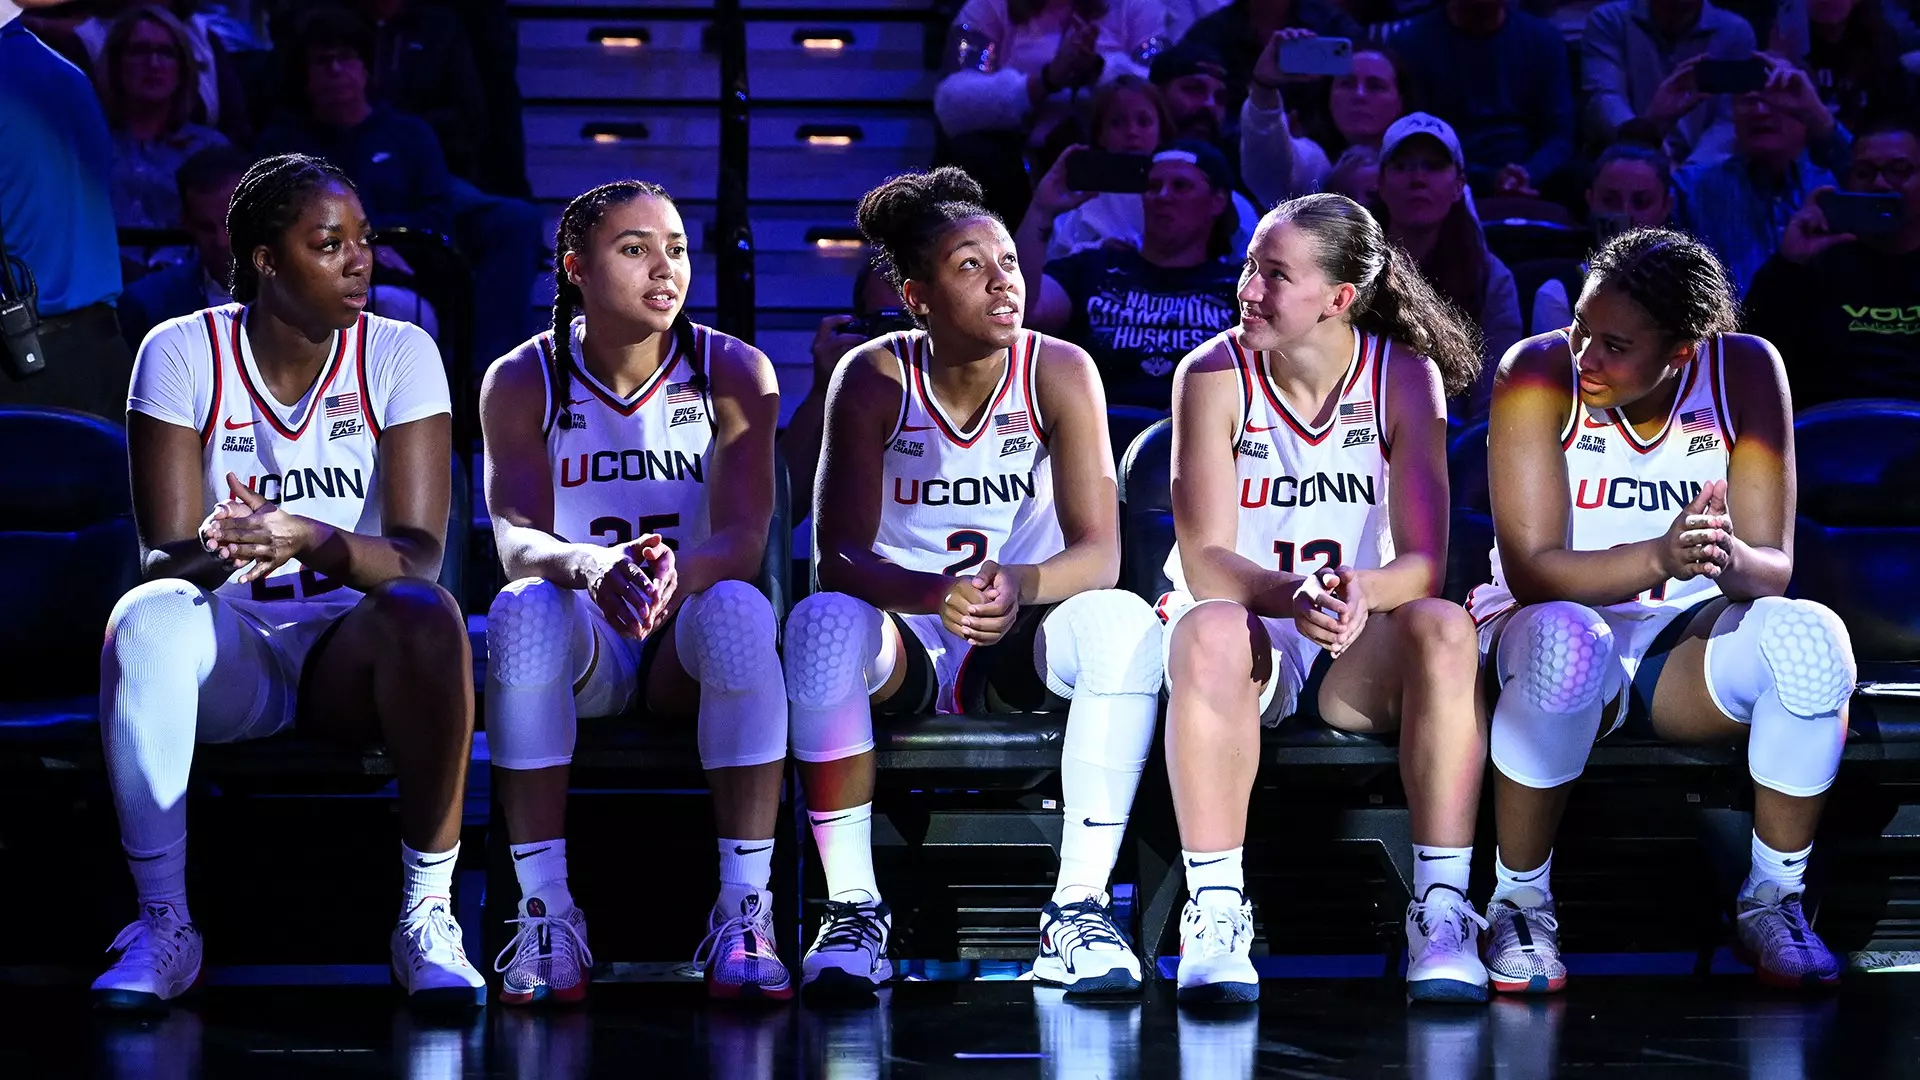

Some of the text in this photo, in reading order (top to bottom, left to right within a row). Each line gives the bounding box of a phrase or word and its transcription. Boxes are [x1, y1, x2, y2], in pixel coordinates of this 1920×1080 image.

[1126, 289, 1204, 312] NATION
[1112, 326, 1205, 350] HUSKIES
[673, 406, 697, 416] BIG
[333, 418, 357, 429] BIG
[671, 412, 704, 423] EAST
[330, 424, 365, 436] EAST
[1347, 427, 1371, 437] BIG
[225, 435, 254, 444] BE THE
[896, 438, 925, 450] BE THE
[1004, 436, 1027, 446] BIG
[1343, 433, 1378, 444] EAST
[1581, 434, 1606, 445] BE THE
[1690, 433, 1714, 444] BIG
[221, 443, 255, 452] CHANGE
[893, 445, 925, 457] CHANGE
[1001, 441, 1033, 453] EAST
[1241, 440, 1269, 451] BE THE
[1576, 441, 1606, 453] CHANGE
[1688, 439, 1720, 452] EAST
[1239, 446, 1269, 459] CHANGE
[560, 449, 704, 488] UCONN
[893, 472, 1036, 506] UCONN
[1240, 472, 1376, 508] UCONN
[942, 530, 988, 577] 2
